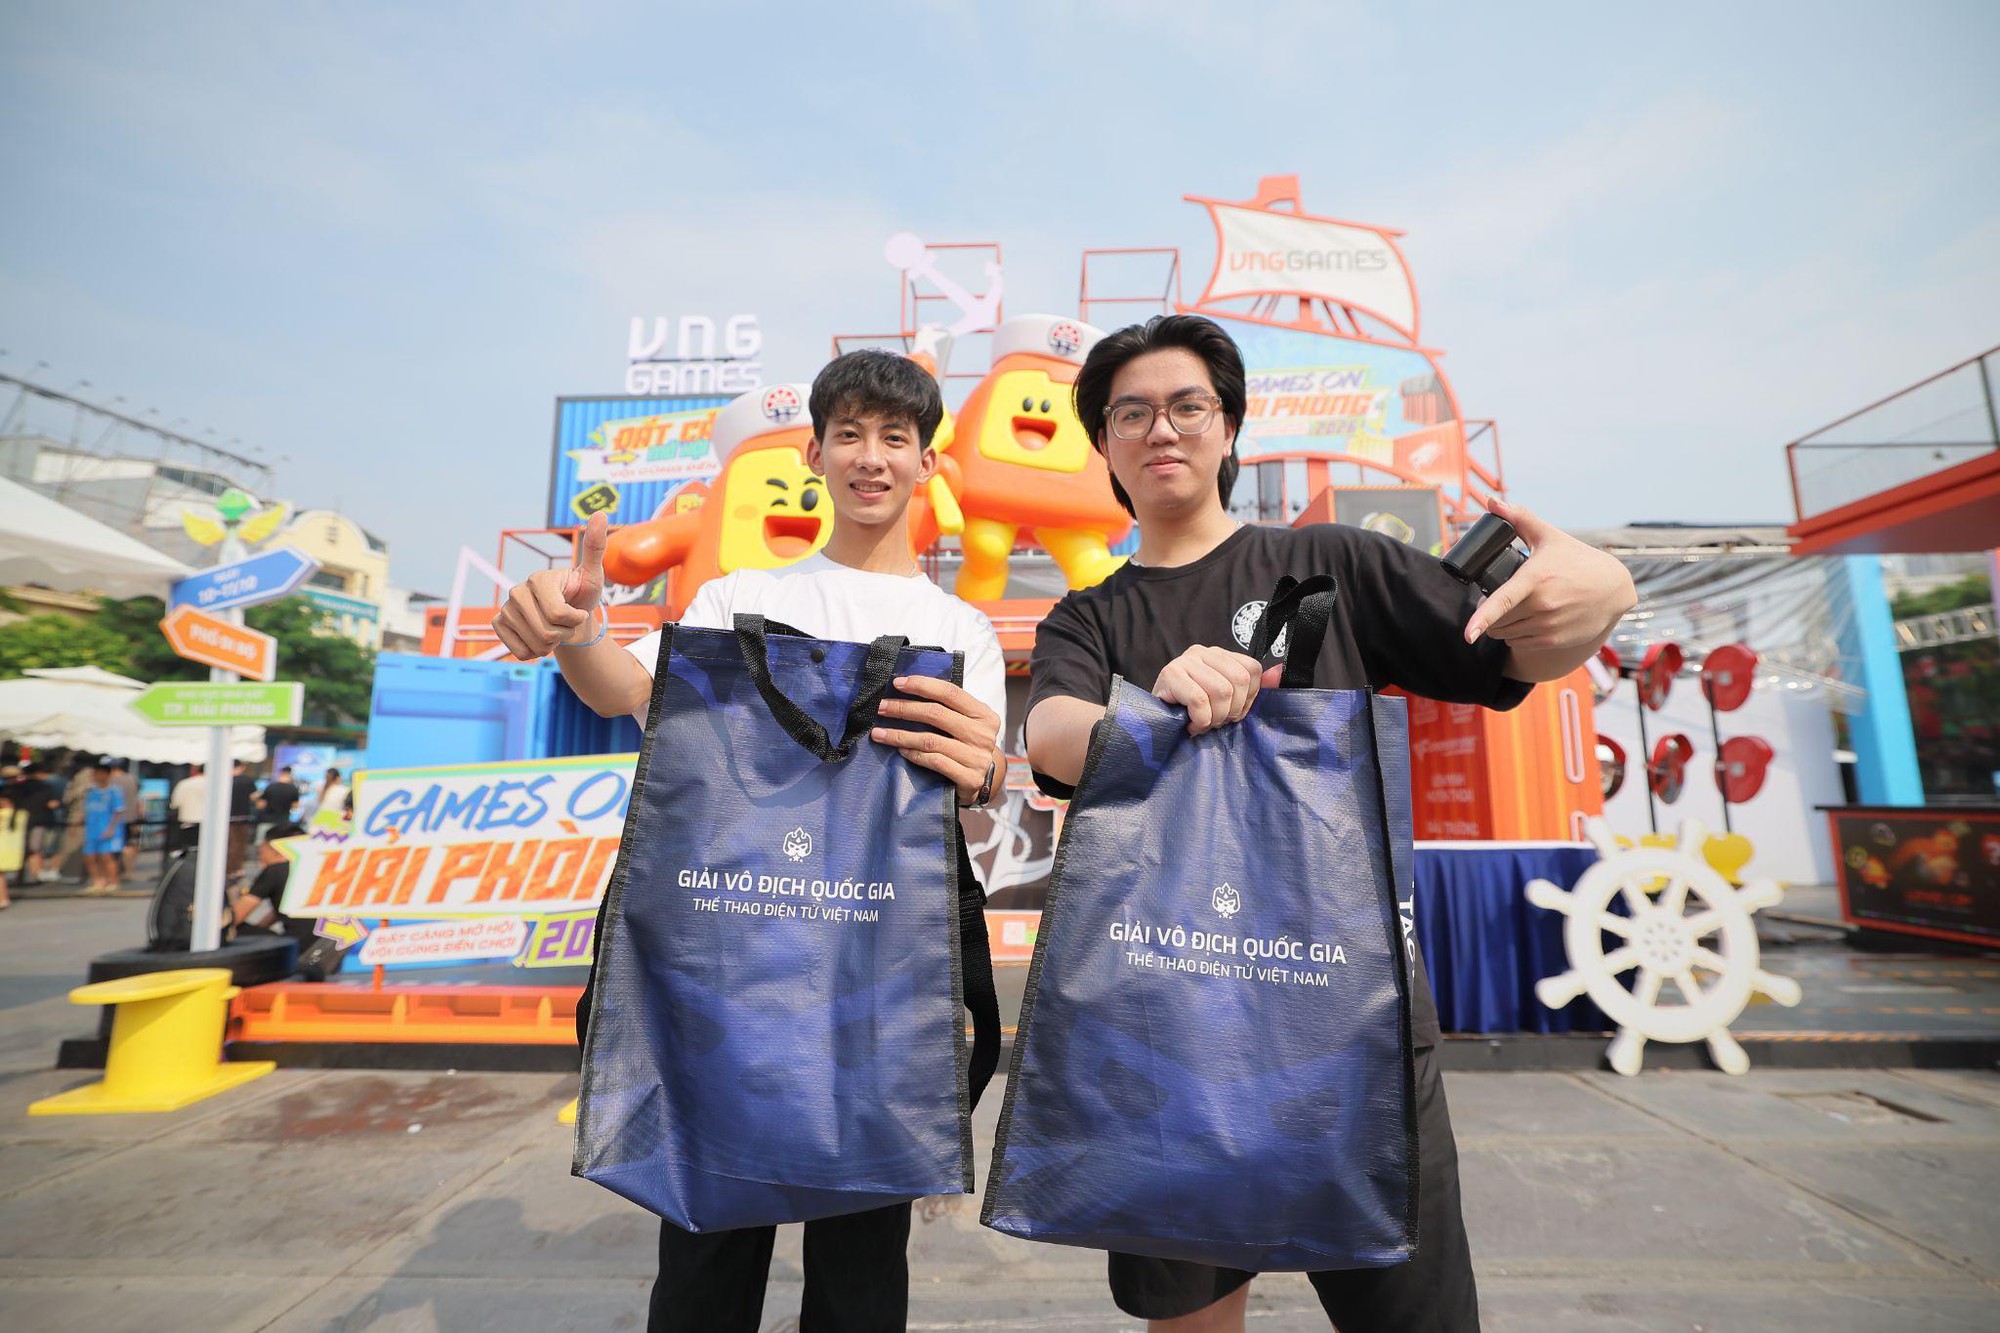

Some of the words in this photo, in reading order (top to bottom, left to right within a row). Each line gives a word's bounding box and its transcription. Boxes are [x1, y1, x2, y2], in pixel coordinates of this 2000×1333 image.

[625, 363, 763, 395] GAMES
[364, 775, 556, 838] GAMES
[566, 771, 628, 821] O
[305, 826, 432, 907] HẢI
[678, 867, 718, 890] GIẢI
[724, 870, 753, 892] VÔ
[758, 876, 805, 899] ĐỊCH
[811, 877, 864, 901] QUỐC
[868, 882, 895, 900] GIA
[693, 896, 719, 912] THỂ
[724, 900, 760, 915] THAO
[764, 902, 796, 919] ĐIỆN
[801, 903, 819, 919] TỬ
[822, 906, 850, 923] VIỆT
[854, 910, 879, 922] NAM
[537, 917, 596, 961] 20
[1109, 920, 1149, 944] GIẢI
[1156, 925, 1186, 948] VÔ
[1191, 932, 1237, 956] ĐỊCH
[1243, 935, 1303, 961] QUỐC
[1310, 943, 1347, 964] GIA
[1126, 951, 1154, 967] THỂ
[1158, 957, 1196, 973] THAO
[1200, 961, 1230, 978] ĐIỆN
[1234, 964, 1253, 980] TỬ
[1257, 968, 1289, 987] VIỆT
[1294, 972, 1329, 987] NAM
